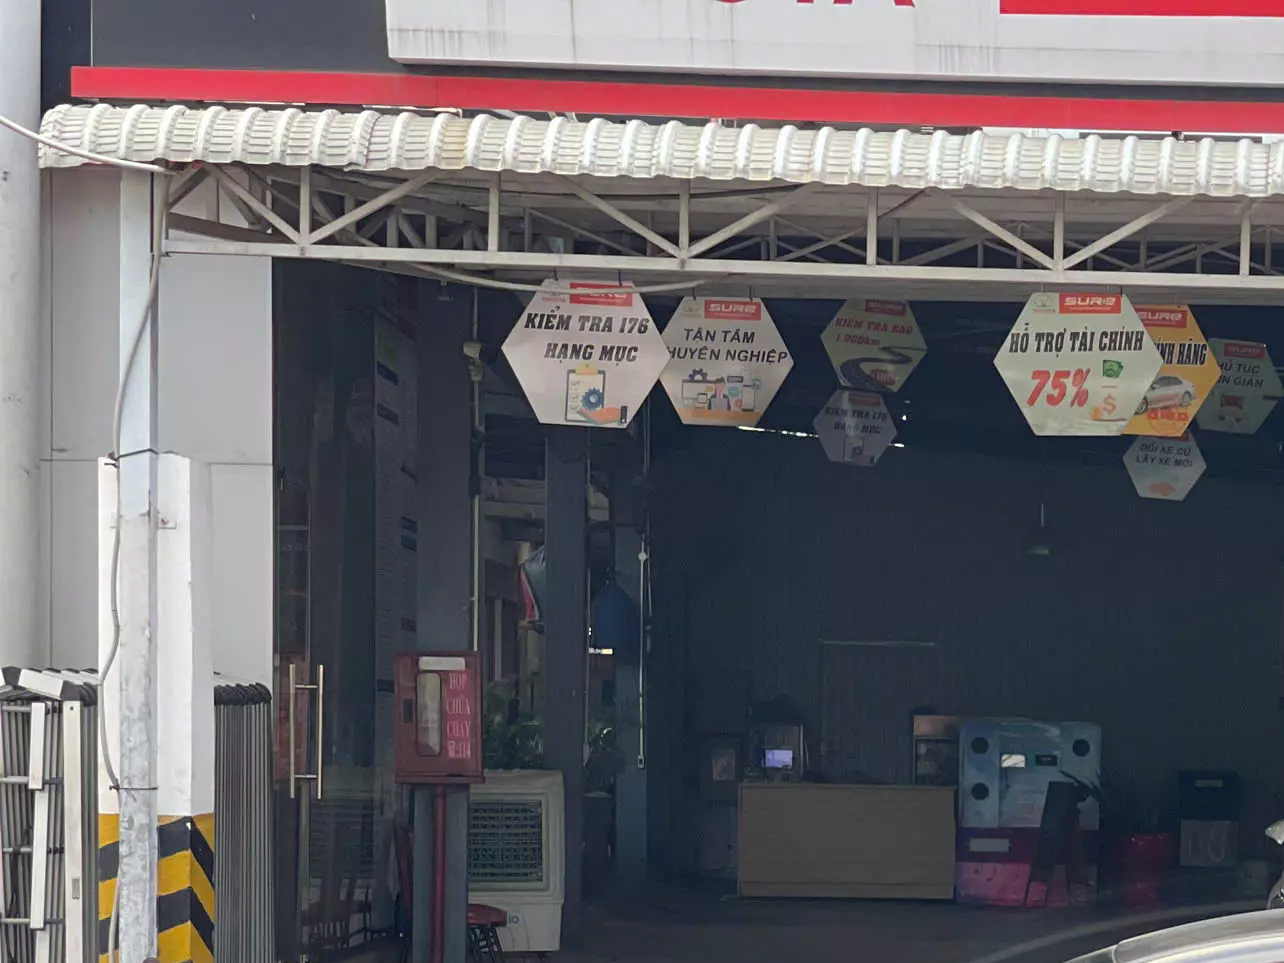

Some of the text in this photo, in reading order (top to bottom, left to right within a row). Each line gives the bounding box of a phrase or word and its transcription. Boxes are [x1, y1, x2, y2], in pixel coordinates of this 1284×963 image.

[709, 303, 757, 313] SURE
[1063, 297, 1116, 306] SURE
[524, 306, 650, 334] KIỂM TRA 176
[722, 329, 755, 343] TÂM
[1009, 322, 1145, 358] HỖ TRỢ TÀI CHÍNH
[544, 343, 638, 366] HẠNG MỤC
[667, 346, 788, 365] HUYÊN NGHIỆP
[1026, 368, 1091, 407] 75%
